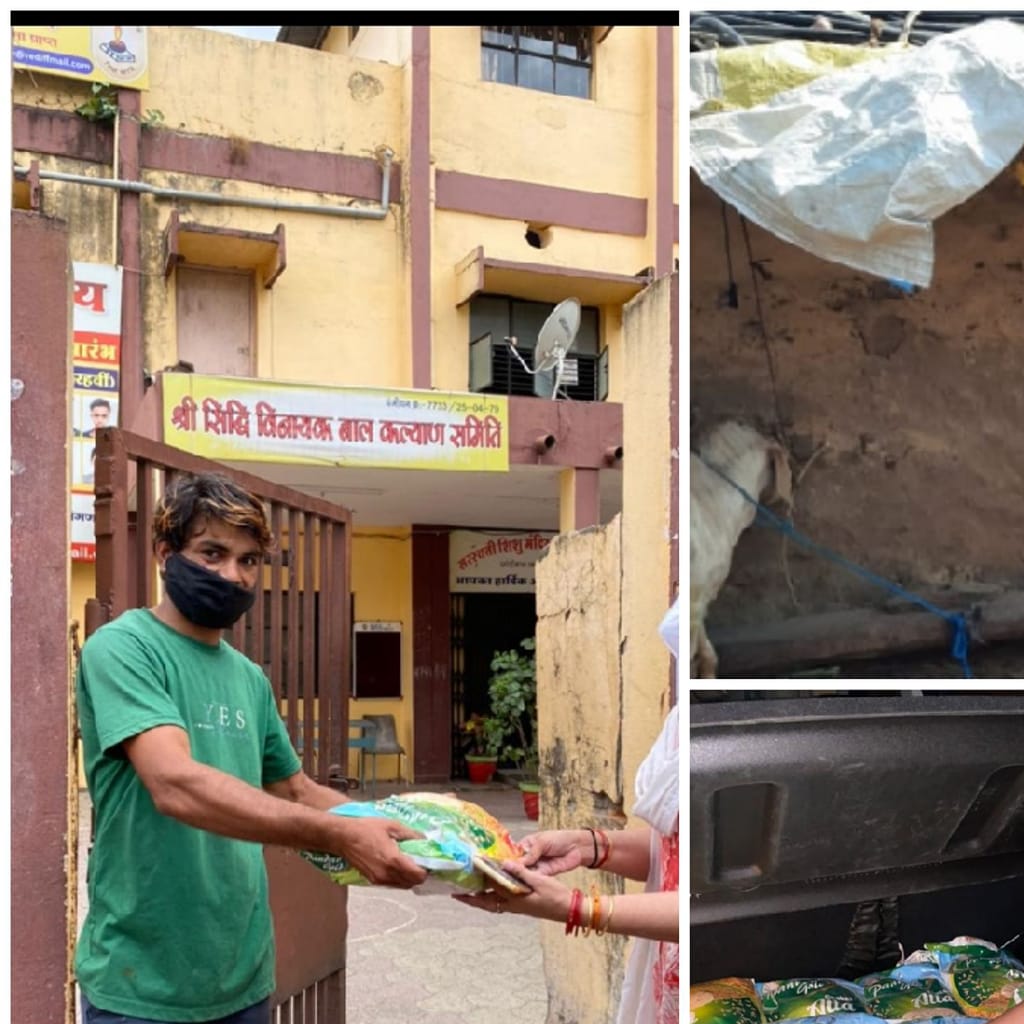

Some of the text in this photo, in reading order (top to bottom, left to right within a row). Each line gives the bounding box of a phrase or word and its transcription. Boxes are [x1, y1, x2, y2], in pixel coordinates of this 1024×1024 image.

[13, 49, 91, 70] @rediffmail.com
[171, 396, 198, 432] श्री
[255, 400, 334, 441] विनायक
[338, 416, 374, 443] बाल
[379, 419, 446, 446] कल्याण
[449, 414, 503, 449] समिति
[524, 531, 551, 551] मंदि
